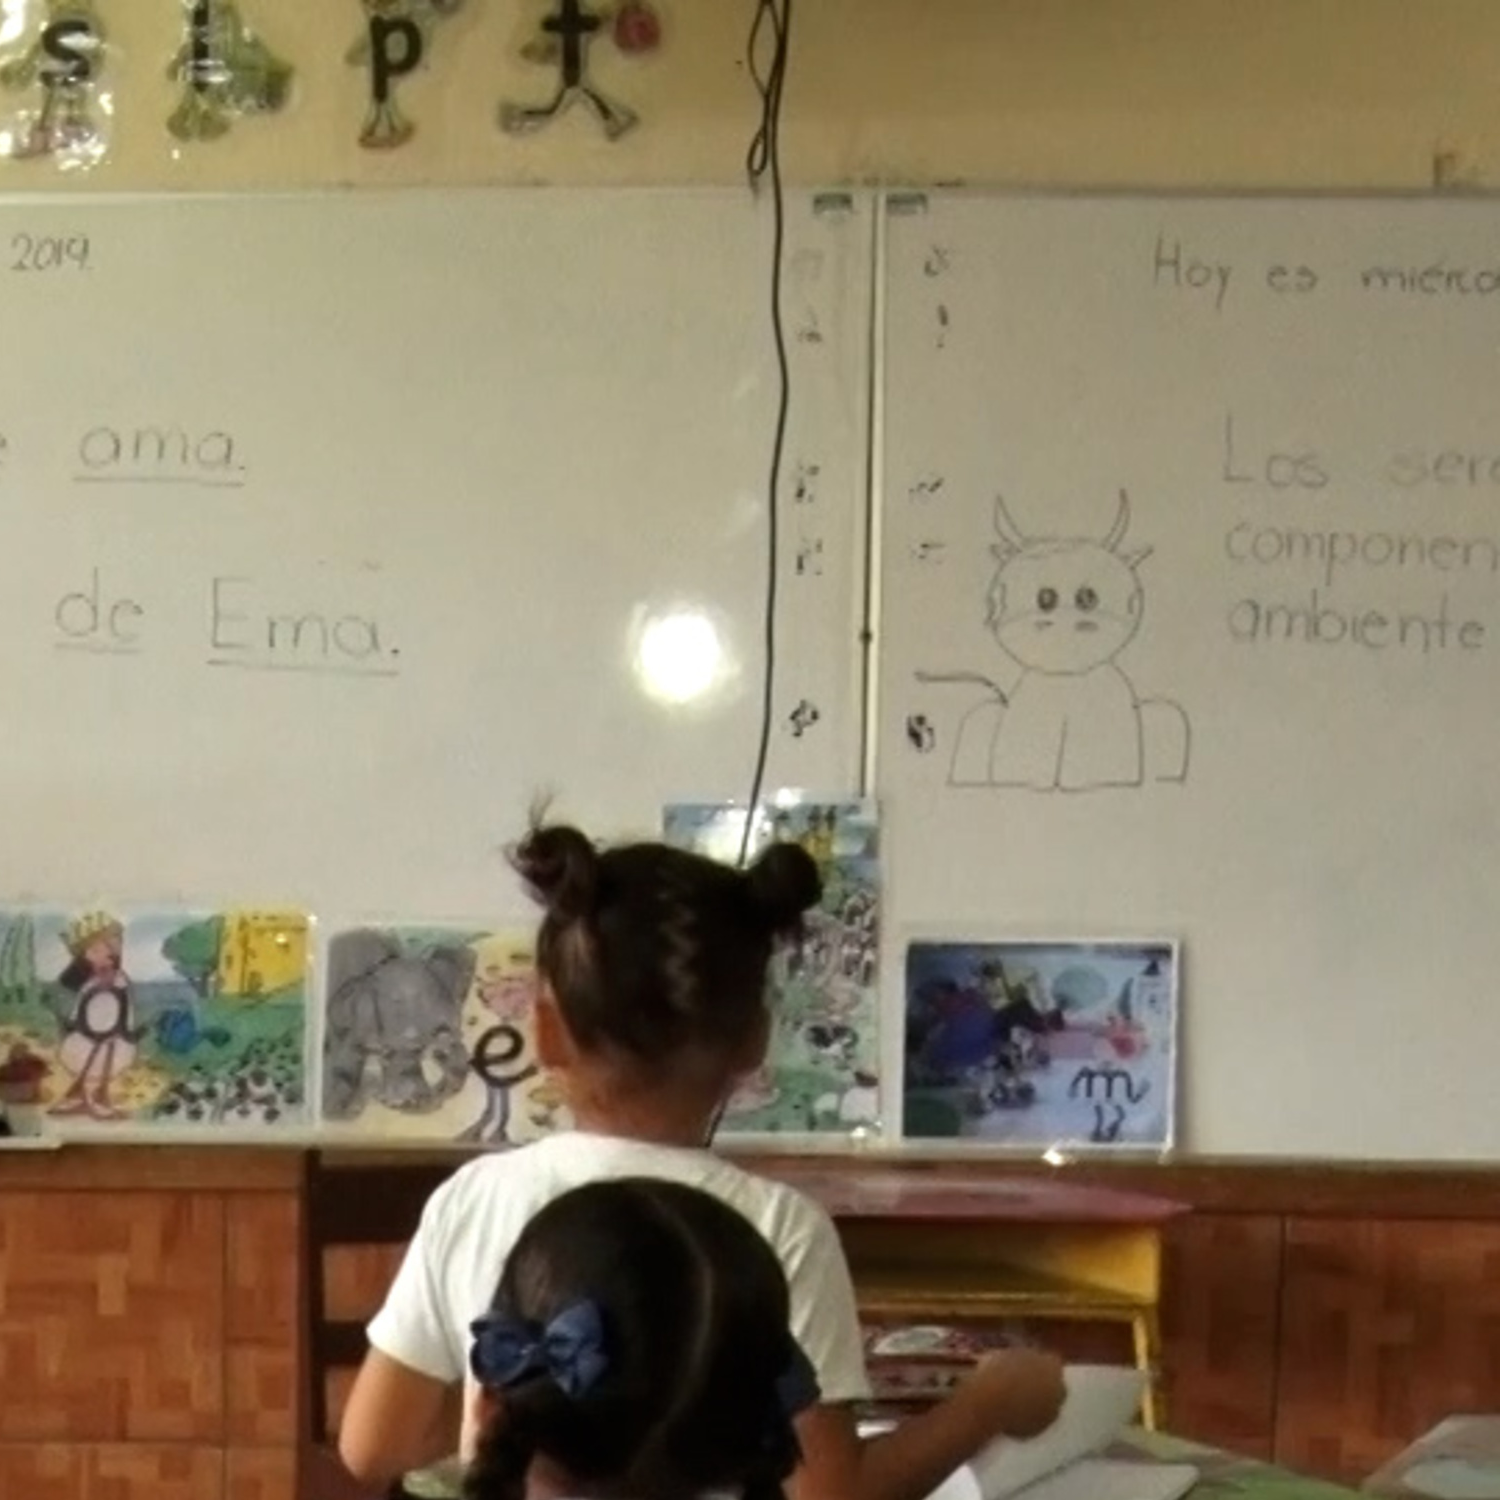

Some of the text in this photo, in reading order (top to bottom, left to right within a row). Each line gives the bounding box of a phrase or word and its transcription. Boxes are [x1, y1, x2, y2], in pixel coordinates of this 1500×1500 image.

[40, 20, 91, 87] s
[369, 14, 422, 103] p
[539, 0, 601, 88] t
[1153, 231, 1232, 312] Hoy
[1266, 264, 1319, 293] es
[1223, 411, 1330, 489] Los
[1224, 520, 1500, 587] componen
[55, 567, 144, 640] de
[211, 576, 401, 658] Ema.
[1227, 588, 1486, 654] ambiente
[472, 1023, 539, 1089] e
[1068, 1065, 1151, 1104] m
